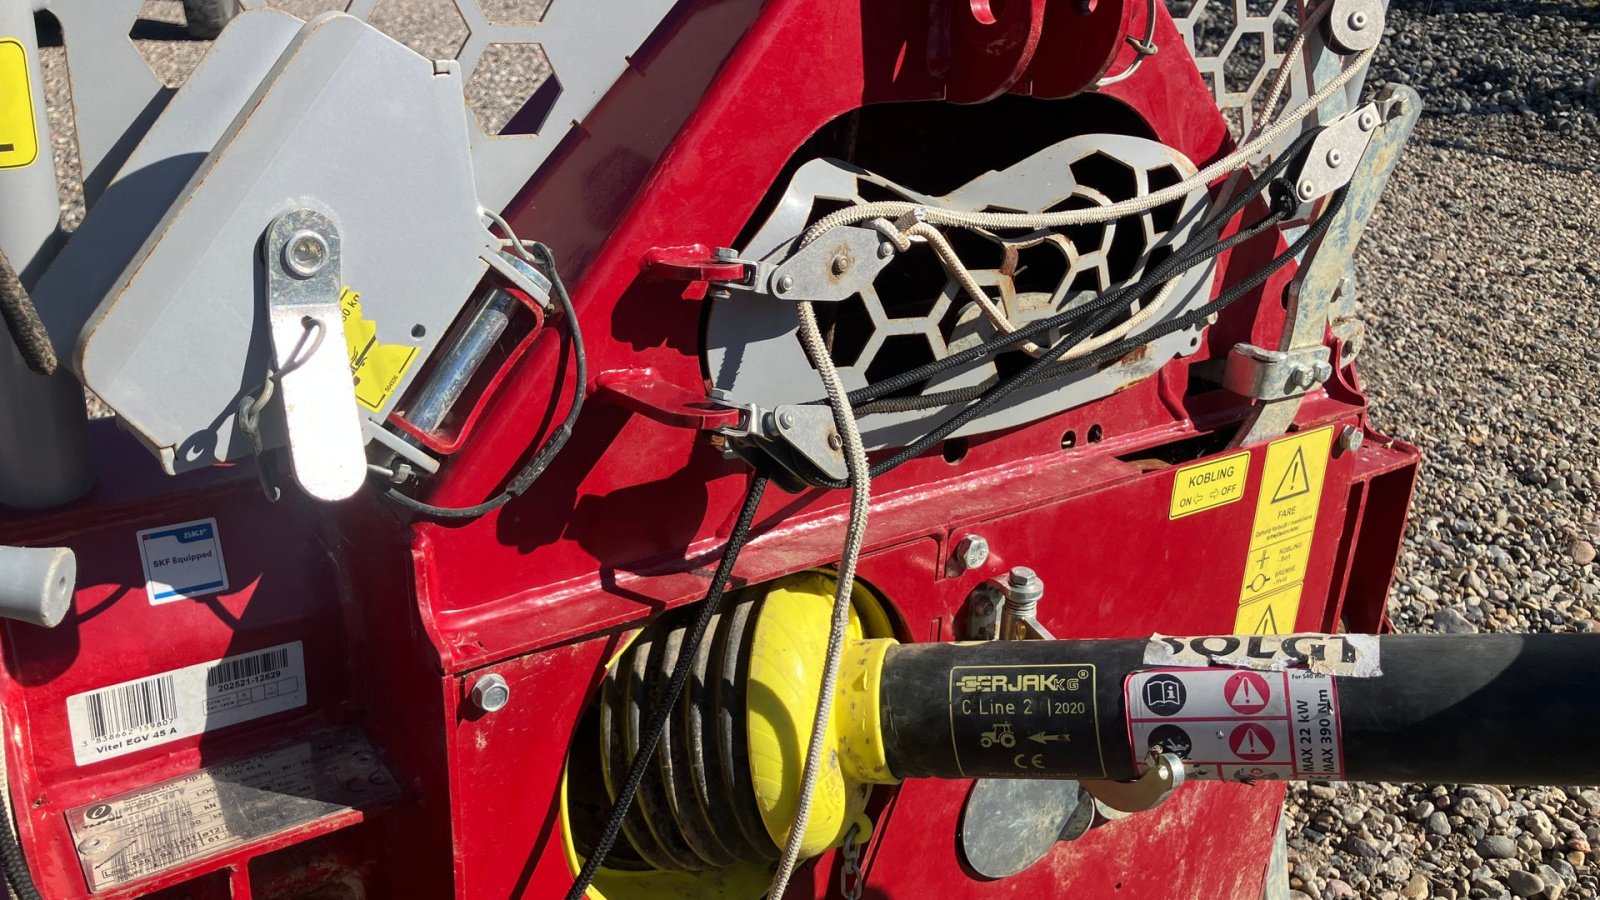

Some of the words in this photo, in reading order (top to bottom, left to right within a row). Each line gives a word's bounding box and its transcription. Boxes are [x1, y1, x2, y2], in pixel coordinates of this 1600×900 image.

[1188, 466, 1234, 488] KOBLING
[1180, 497, 1193, 508] ON
[1221, 484, 1237, 496] OFF
[1277, 506, 1297, 519] FARE
[183, 528, 208, 539] SKF
[153, 557, 171, 568] SKF
[172, 550, 213, 564] Equipped
[962, 699, 972, 715] C
[979, 699, 1016, 715] Line
[1023, 698, 1033, 714] 2
[1055, 702, 1085, 714] 2020
[1296, 700, 1310, 723] kW
[1317, 689, 1329, 714] Nm
[96, 741, 123, 753] Vitel
[126, 734, 150, 746] EGV
[152, 730, 167, 738] 45
[169, 727, 178, 735] A
[1299, 728, 1312, 745] 22
[1318, 718, 1333, 744] 390
[1300, 748, 1315, 773] MAX
[1321, 748, 1335, 773] MAX
[203, 802, 217, 810] kN
